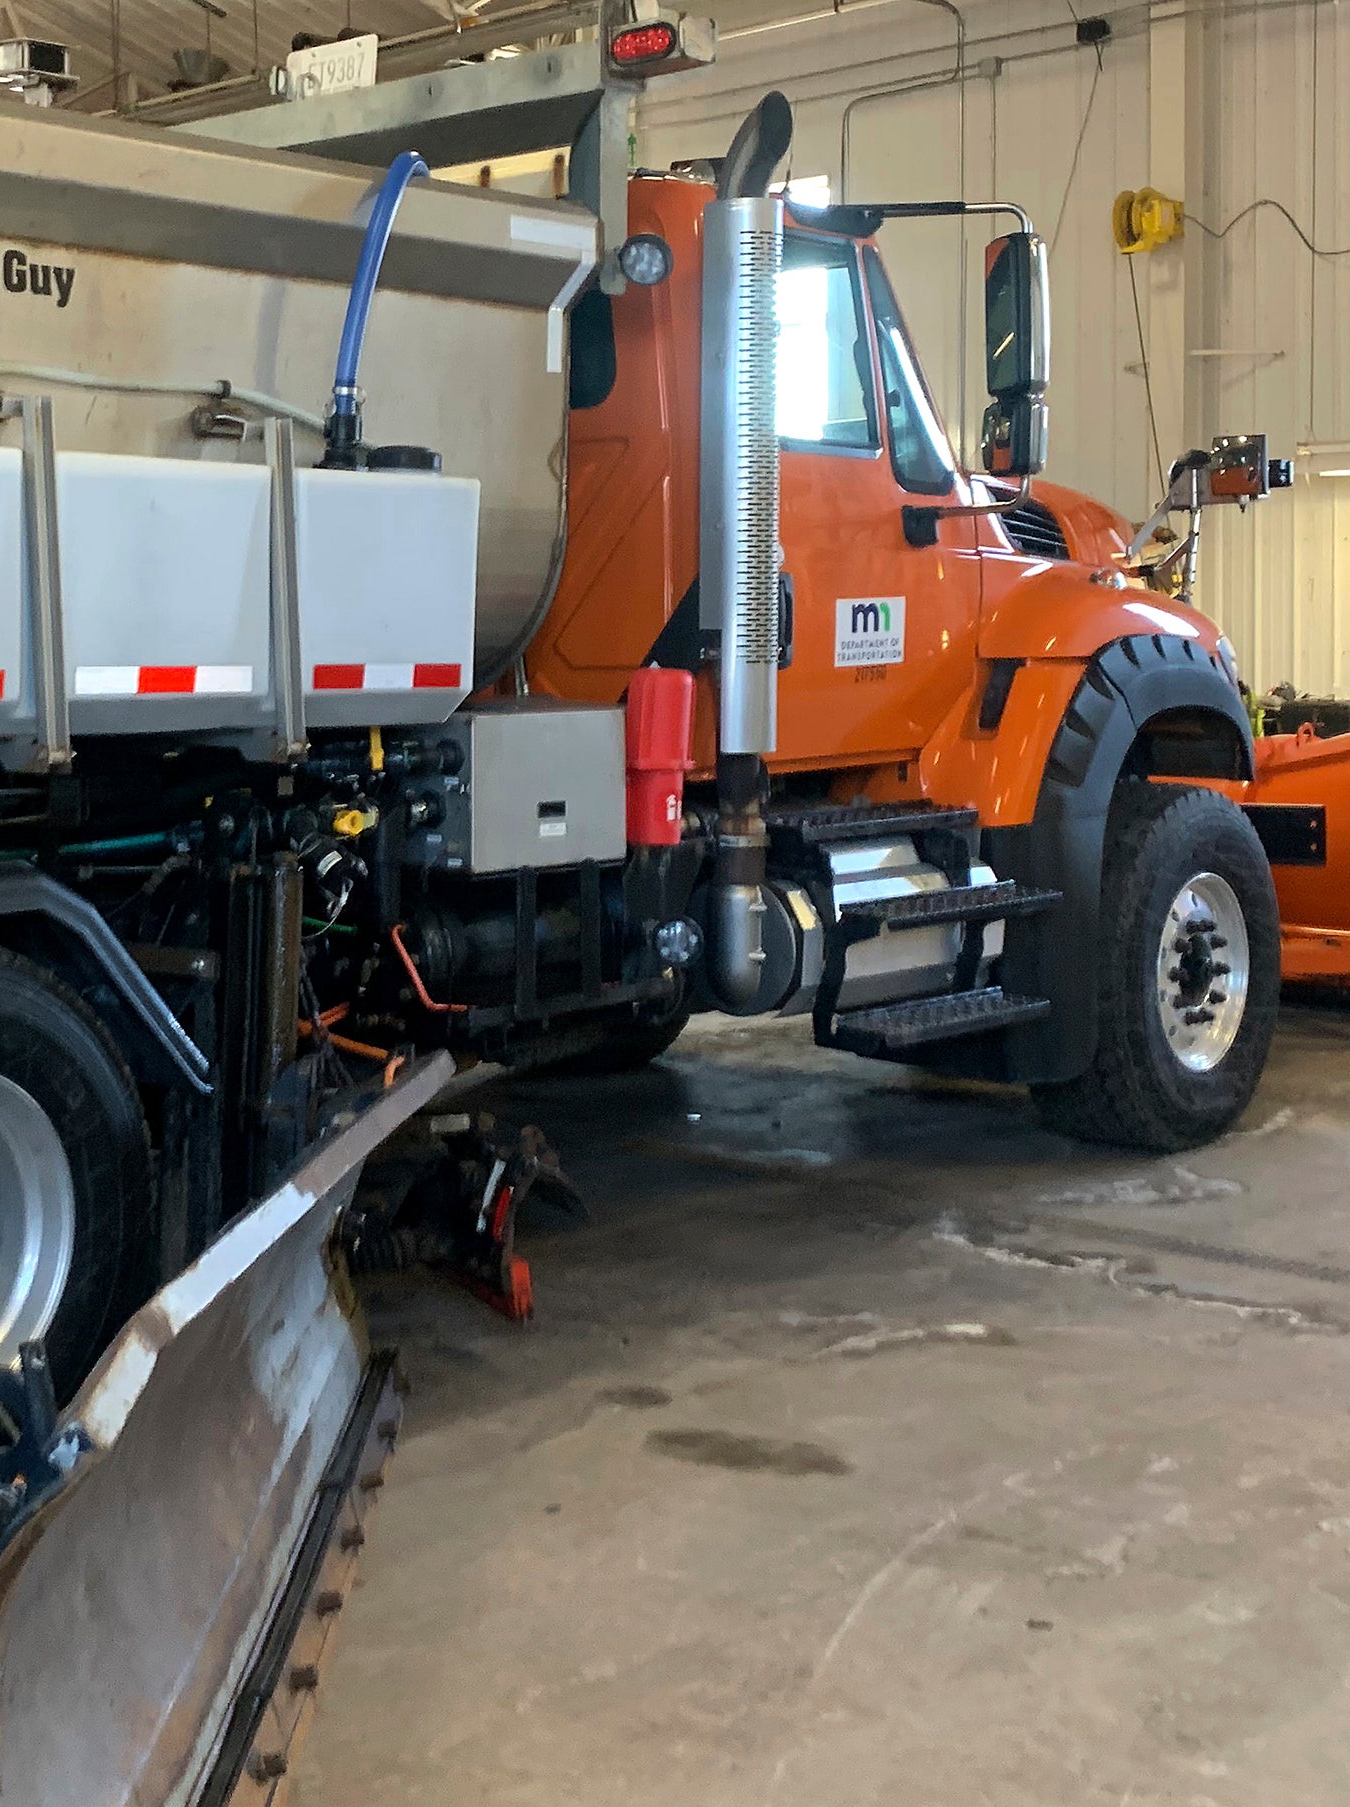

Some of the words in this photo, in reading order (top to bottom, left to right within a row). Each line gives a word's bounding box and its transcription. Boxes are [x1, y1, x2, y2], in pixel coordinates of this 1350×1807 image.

[2, 248, 76, 308] Guy
[840, 638, 889, 650] DEPARTMENT
[890, 637, 900, 647] OF
[837, 650, 902, 661] TRANSPORTATION
